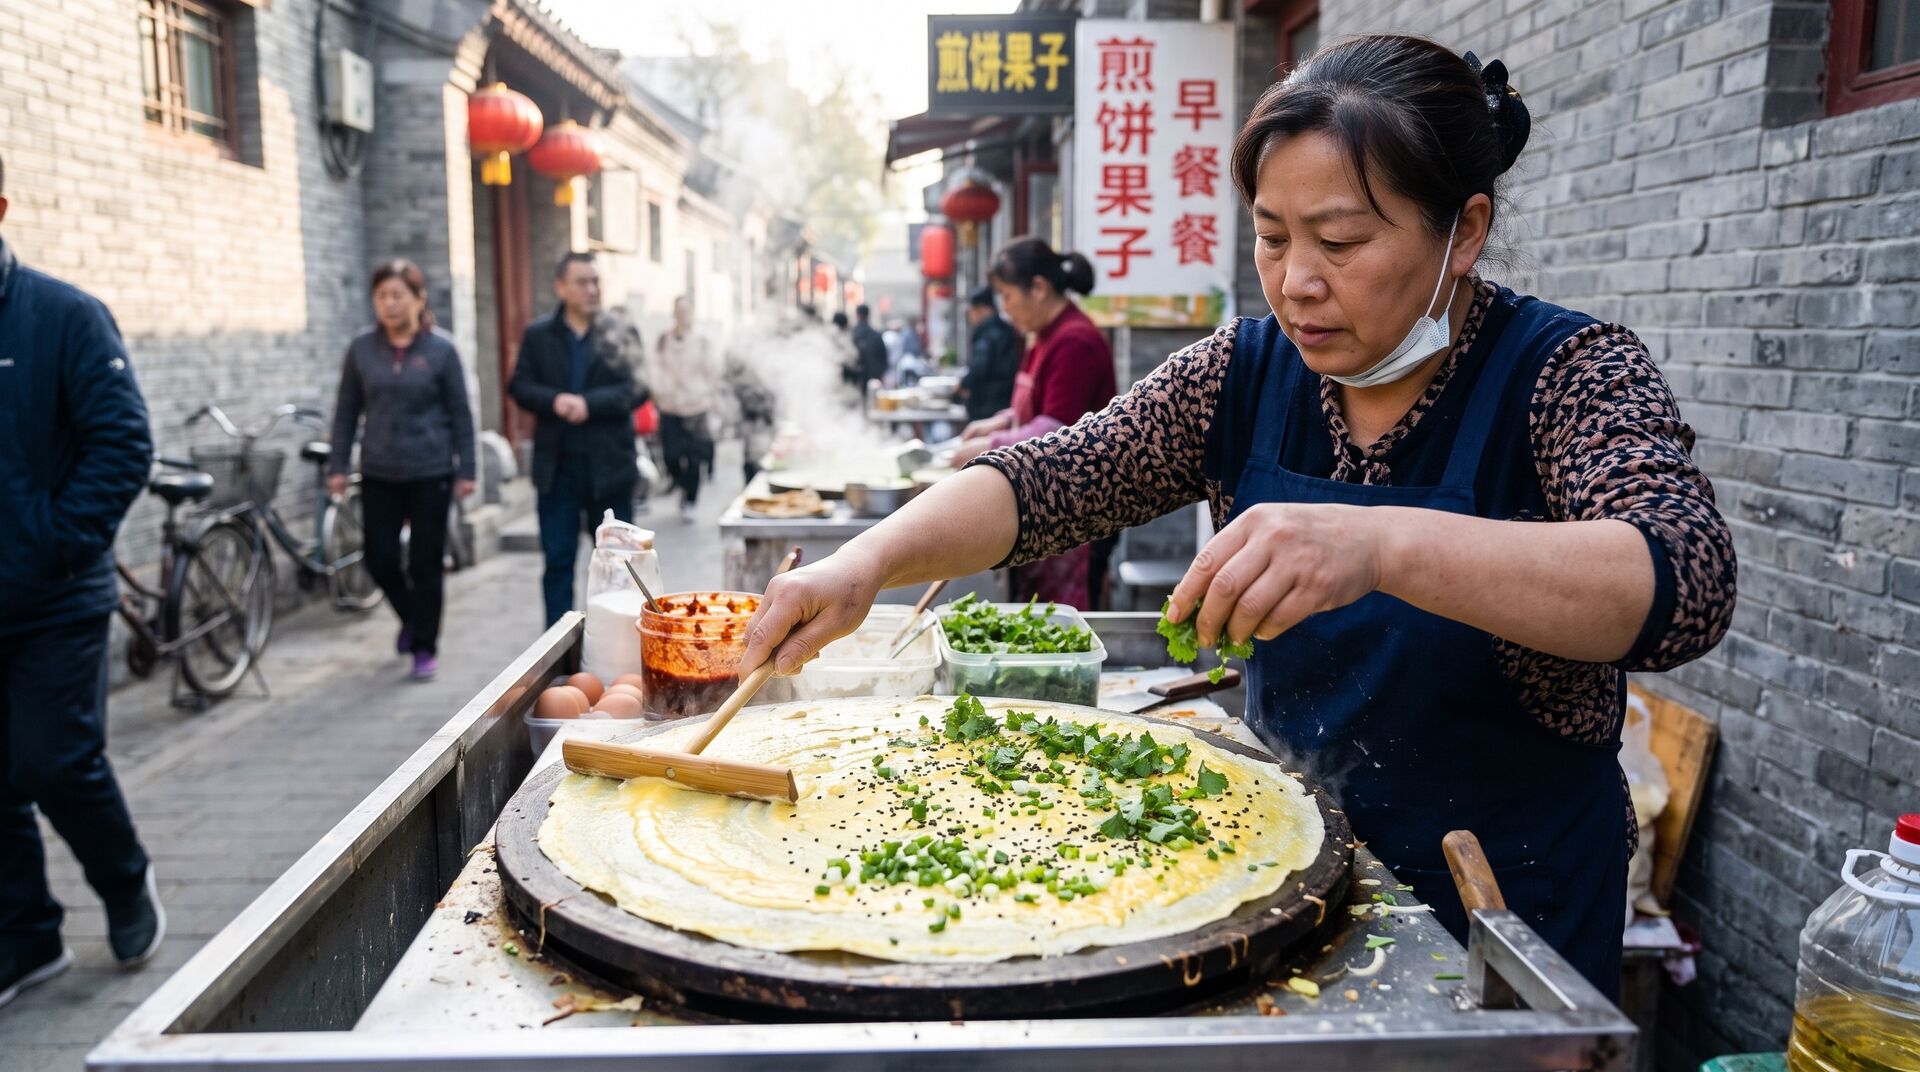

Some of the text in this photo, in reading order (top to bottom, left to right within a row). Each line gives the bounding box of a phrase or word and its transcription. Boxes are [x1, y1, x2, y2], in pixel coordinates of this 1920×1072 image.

[936, 31, 1069, 93] 煎饼果子
[1096, 36, 1155, 279] 煎饼果子
[1172, 80, 1221, 266] 早餐餐
